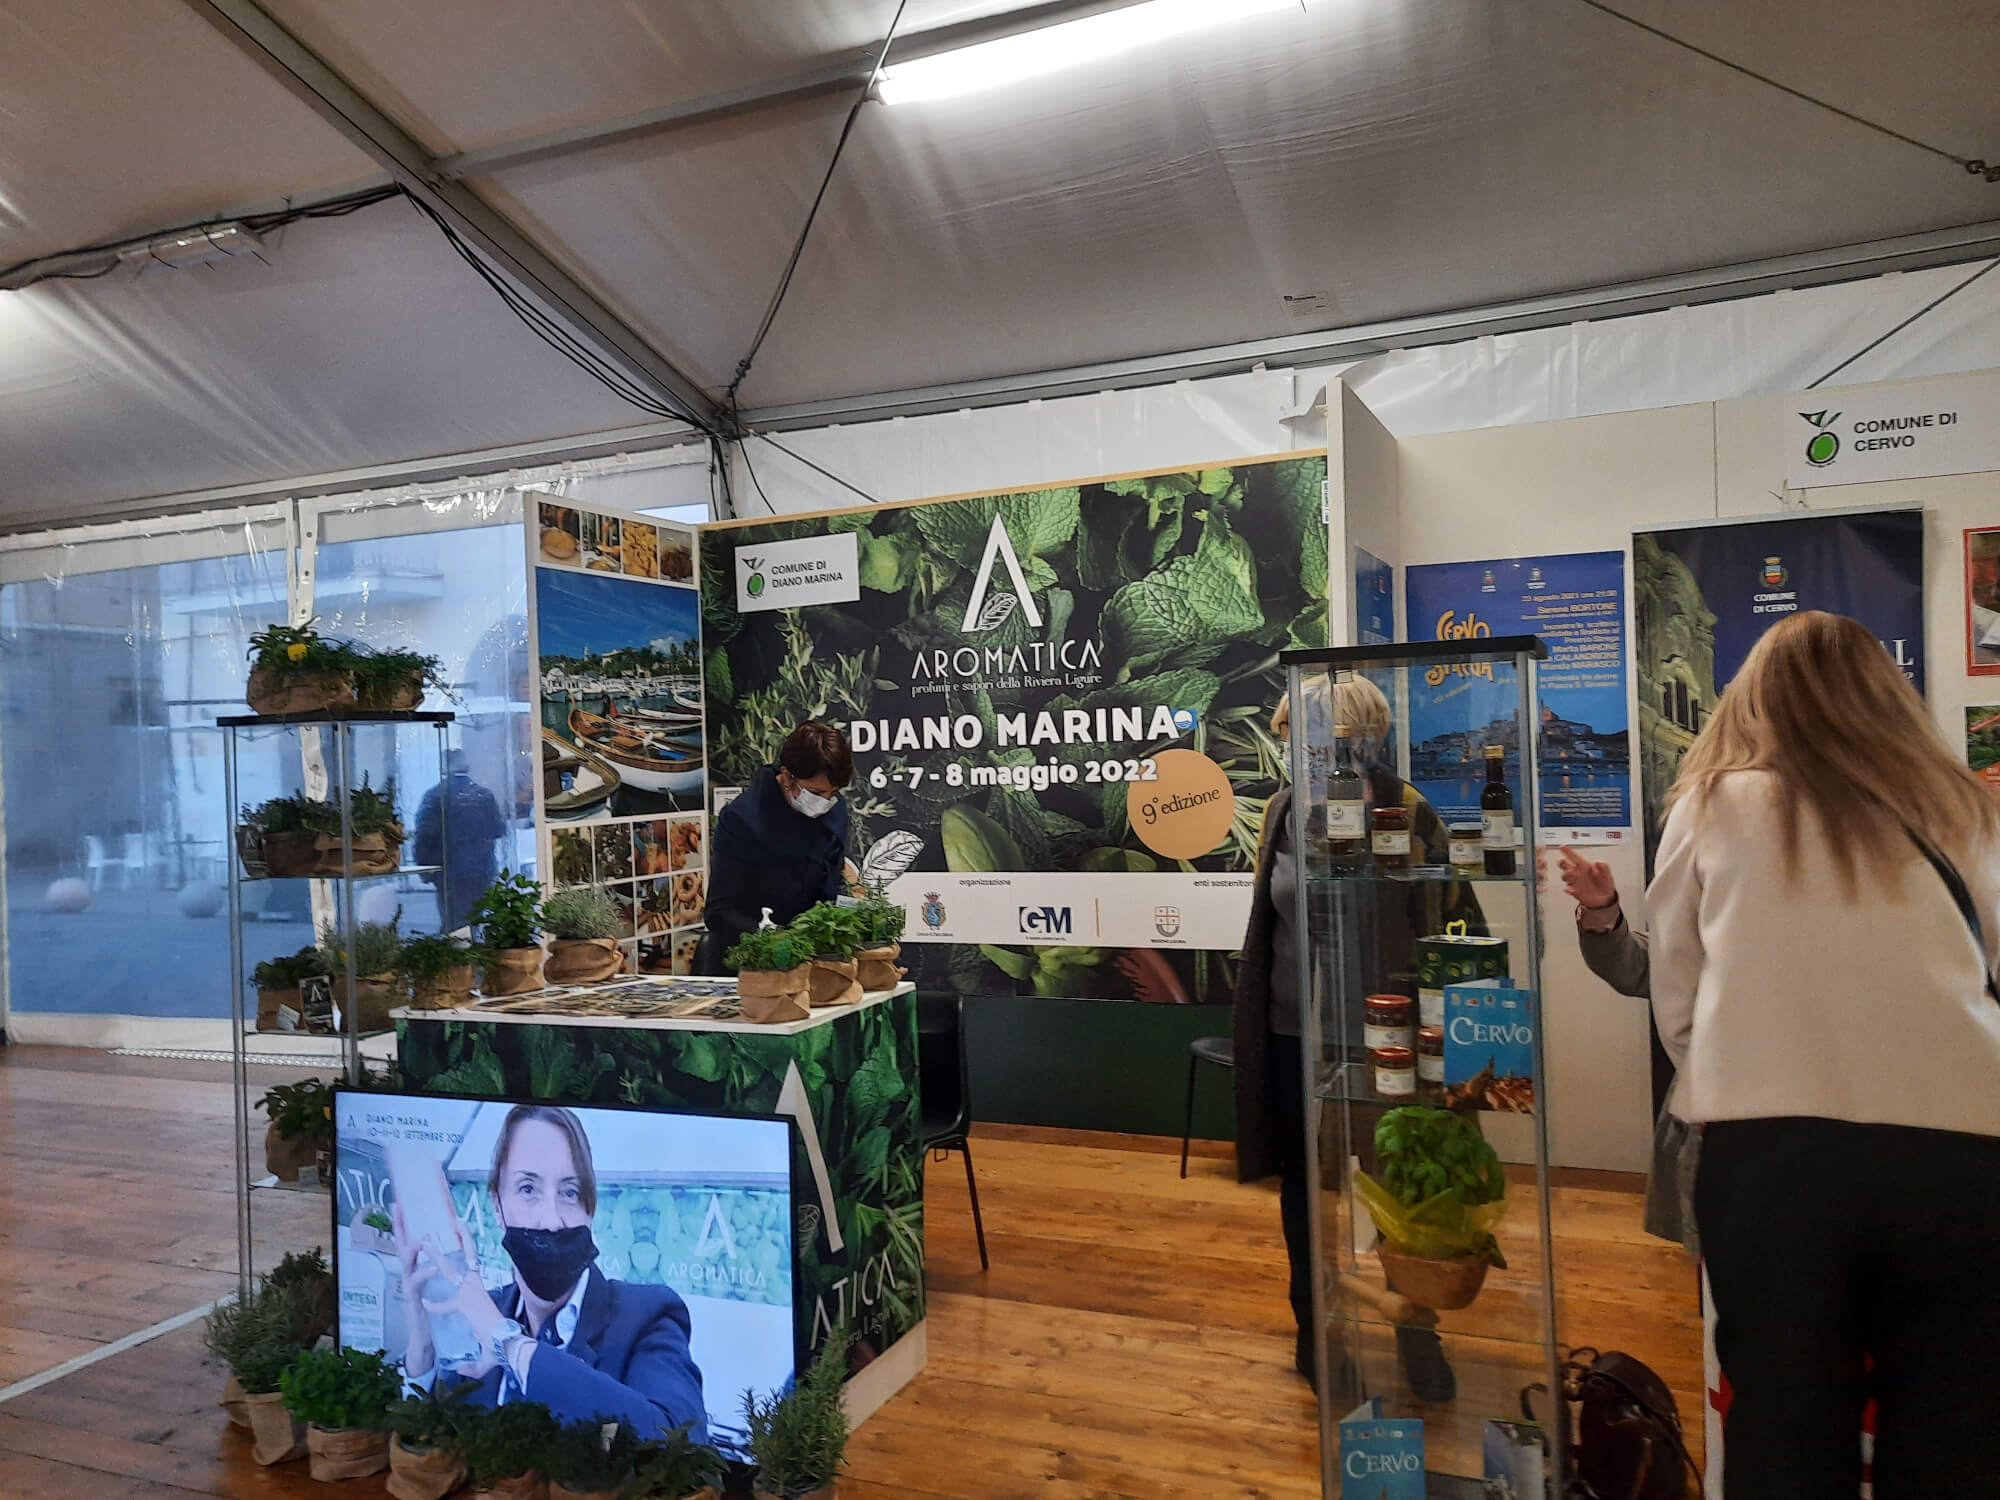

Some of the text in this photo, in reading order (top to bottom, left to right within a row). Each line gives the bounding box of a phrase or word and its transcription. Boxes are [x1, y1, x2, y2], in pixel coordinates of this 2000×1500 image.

[1854, 412, 1957, 434] COMUNE DI
[1854, 435, 1915, 452] CERVO
[771, 560, 827, 575] COMUNE DI
[772, 572, 843, 588] DIANO MARINA
[1753, 591, 1797, 602] COMUNE
[1753, 603, 1798, 613] DI CERVO
[911, 638, 1101, 680] AROMATICA
[911, 681, 950, 698] profumi
[962, 682, 994, 695] sapori
[997, 677, 1021, 689] della
[1024, 674, 1062, 688] Riviera
[1065, 673, 1102, 689] Ligure
[850, 704, 1180, 753] DIANO MARINA
[870, 766, 888, 788] 6
[907, 766, 924, 790] 7
[945, 764, 963, 787] 8
[970, 756, 1078, 792] maggio
[1084, 758, 1158, 783] 2022
[1160, 786, 1221, 815] edizione
[959, 878, 1011, 888] organizzazione
[1193, 879, 1209, 887] enti
[1449, 1016, 1533, 1045] CERVO
[366, 1113, 429, 1127] DIANO MARINA
[404, 1130, 443, 1142] SETTEMBRE
[668, 1262, 766, 1288] AROMATICA
[1346, 1450, 1420, 1478] CERVO
